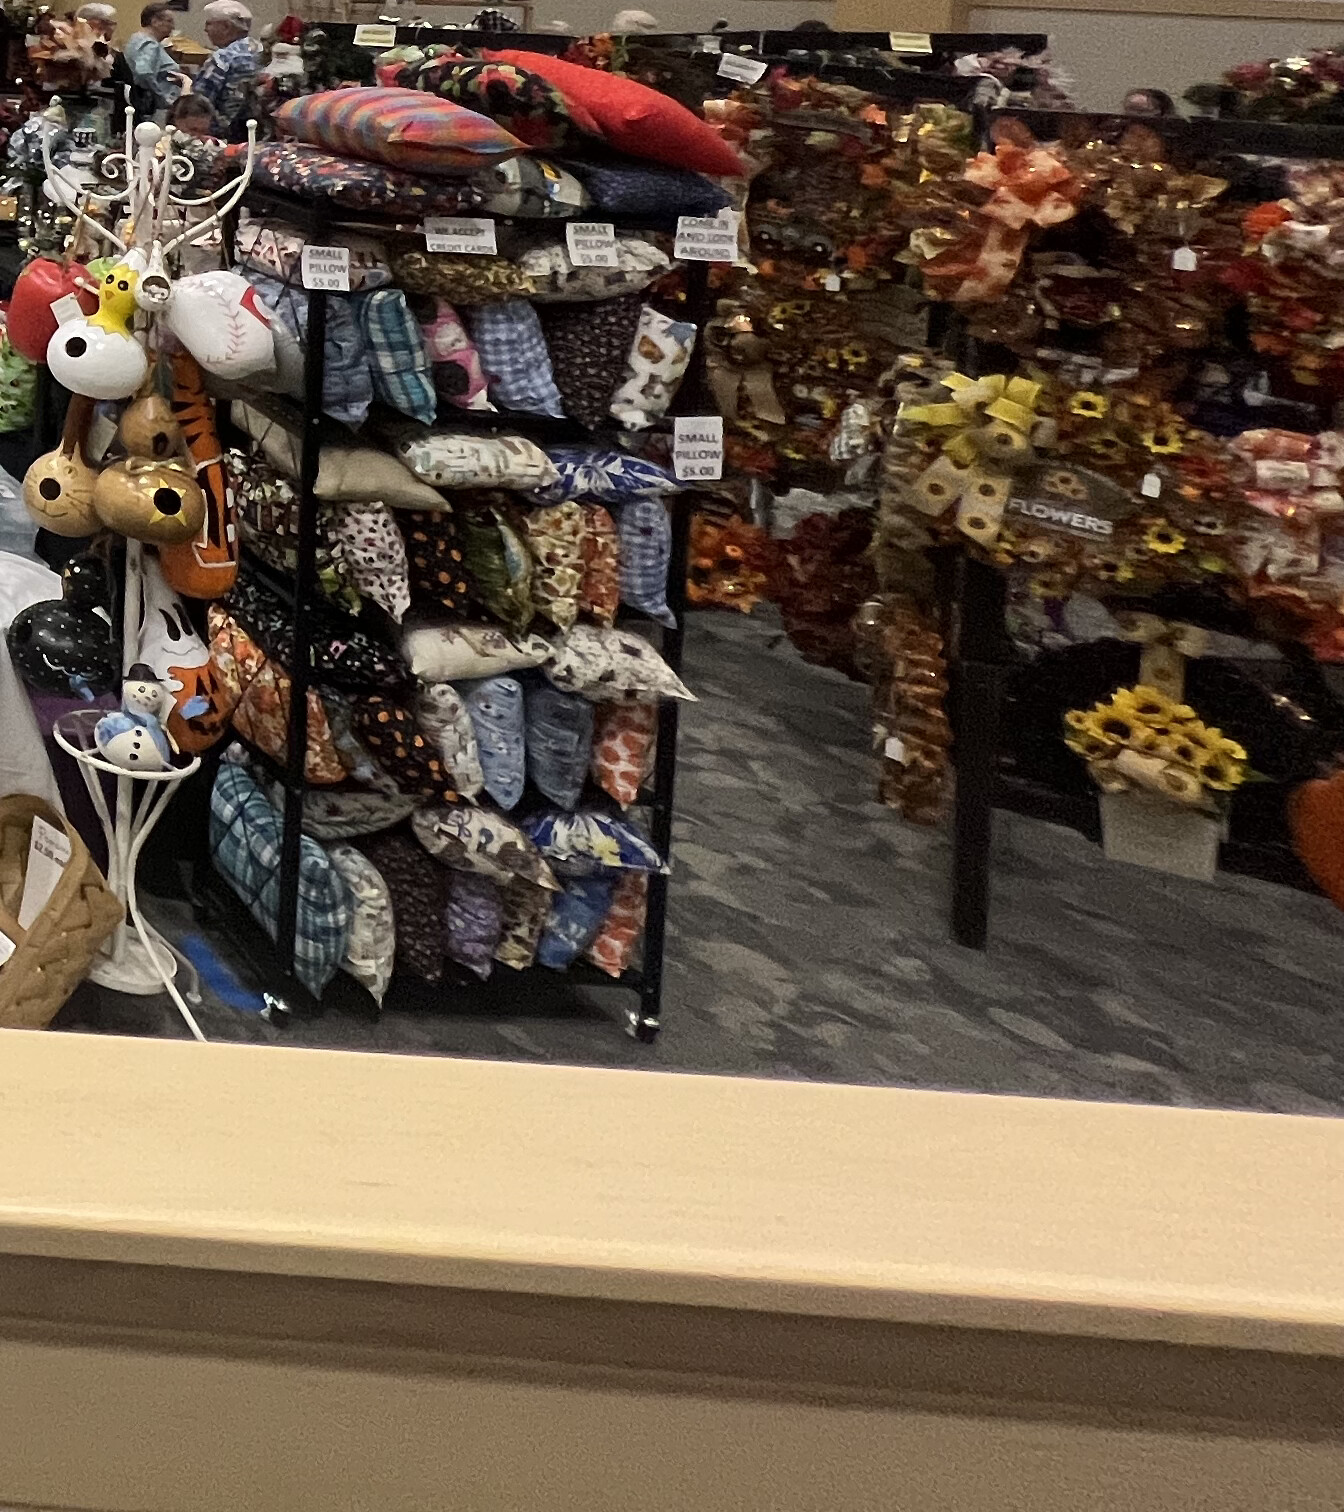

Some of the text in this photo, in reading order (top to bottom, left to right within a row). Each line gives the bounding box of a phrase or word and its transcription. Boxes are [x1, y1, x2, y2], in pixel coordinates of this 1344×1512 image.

[309, 249, 343, 260] SMALL
[309, 263, 348, 275] PILLOW
[678, 433, 718, 444] SMALL
[675, 449, 722, 460] PILLOW
[1009, 497, 1114, 535] FLOWERS
